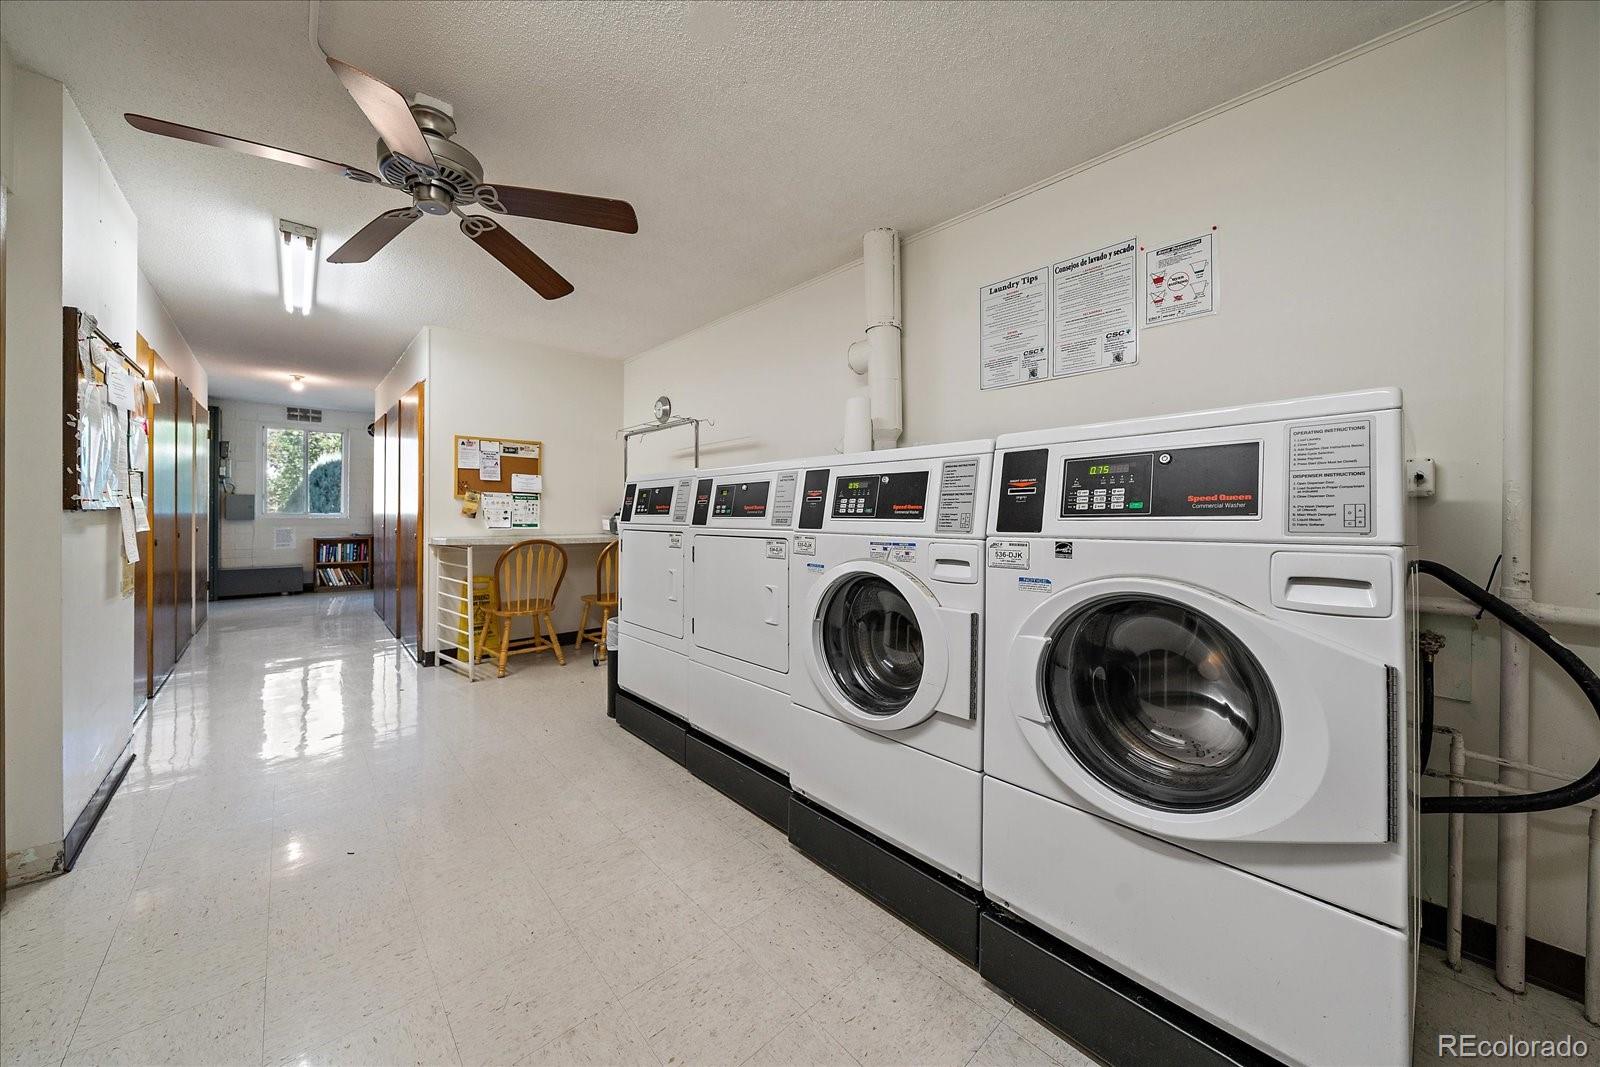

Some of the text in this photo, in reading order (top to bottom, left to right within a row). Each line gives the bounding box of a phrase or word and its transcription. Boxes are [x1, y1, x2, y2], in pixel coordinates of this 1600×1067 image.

[1055, 262, 1079, 274] Consejos
[1088, 252, 1107, 264] lavado
[1114, 244, 1134, 256] secado
[989, 276, 1038, 295] Laundry Tips
[1106, 330, 1125, 339] CSC
